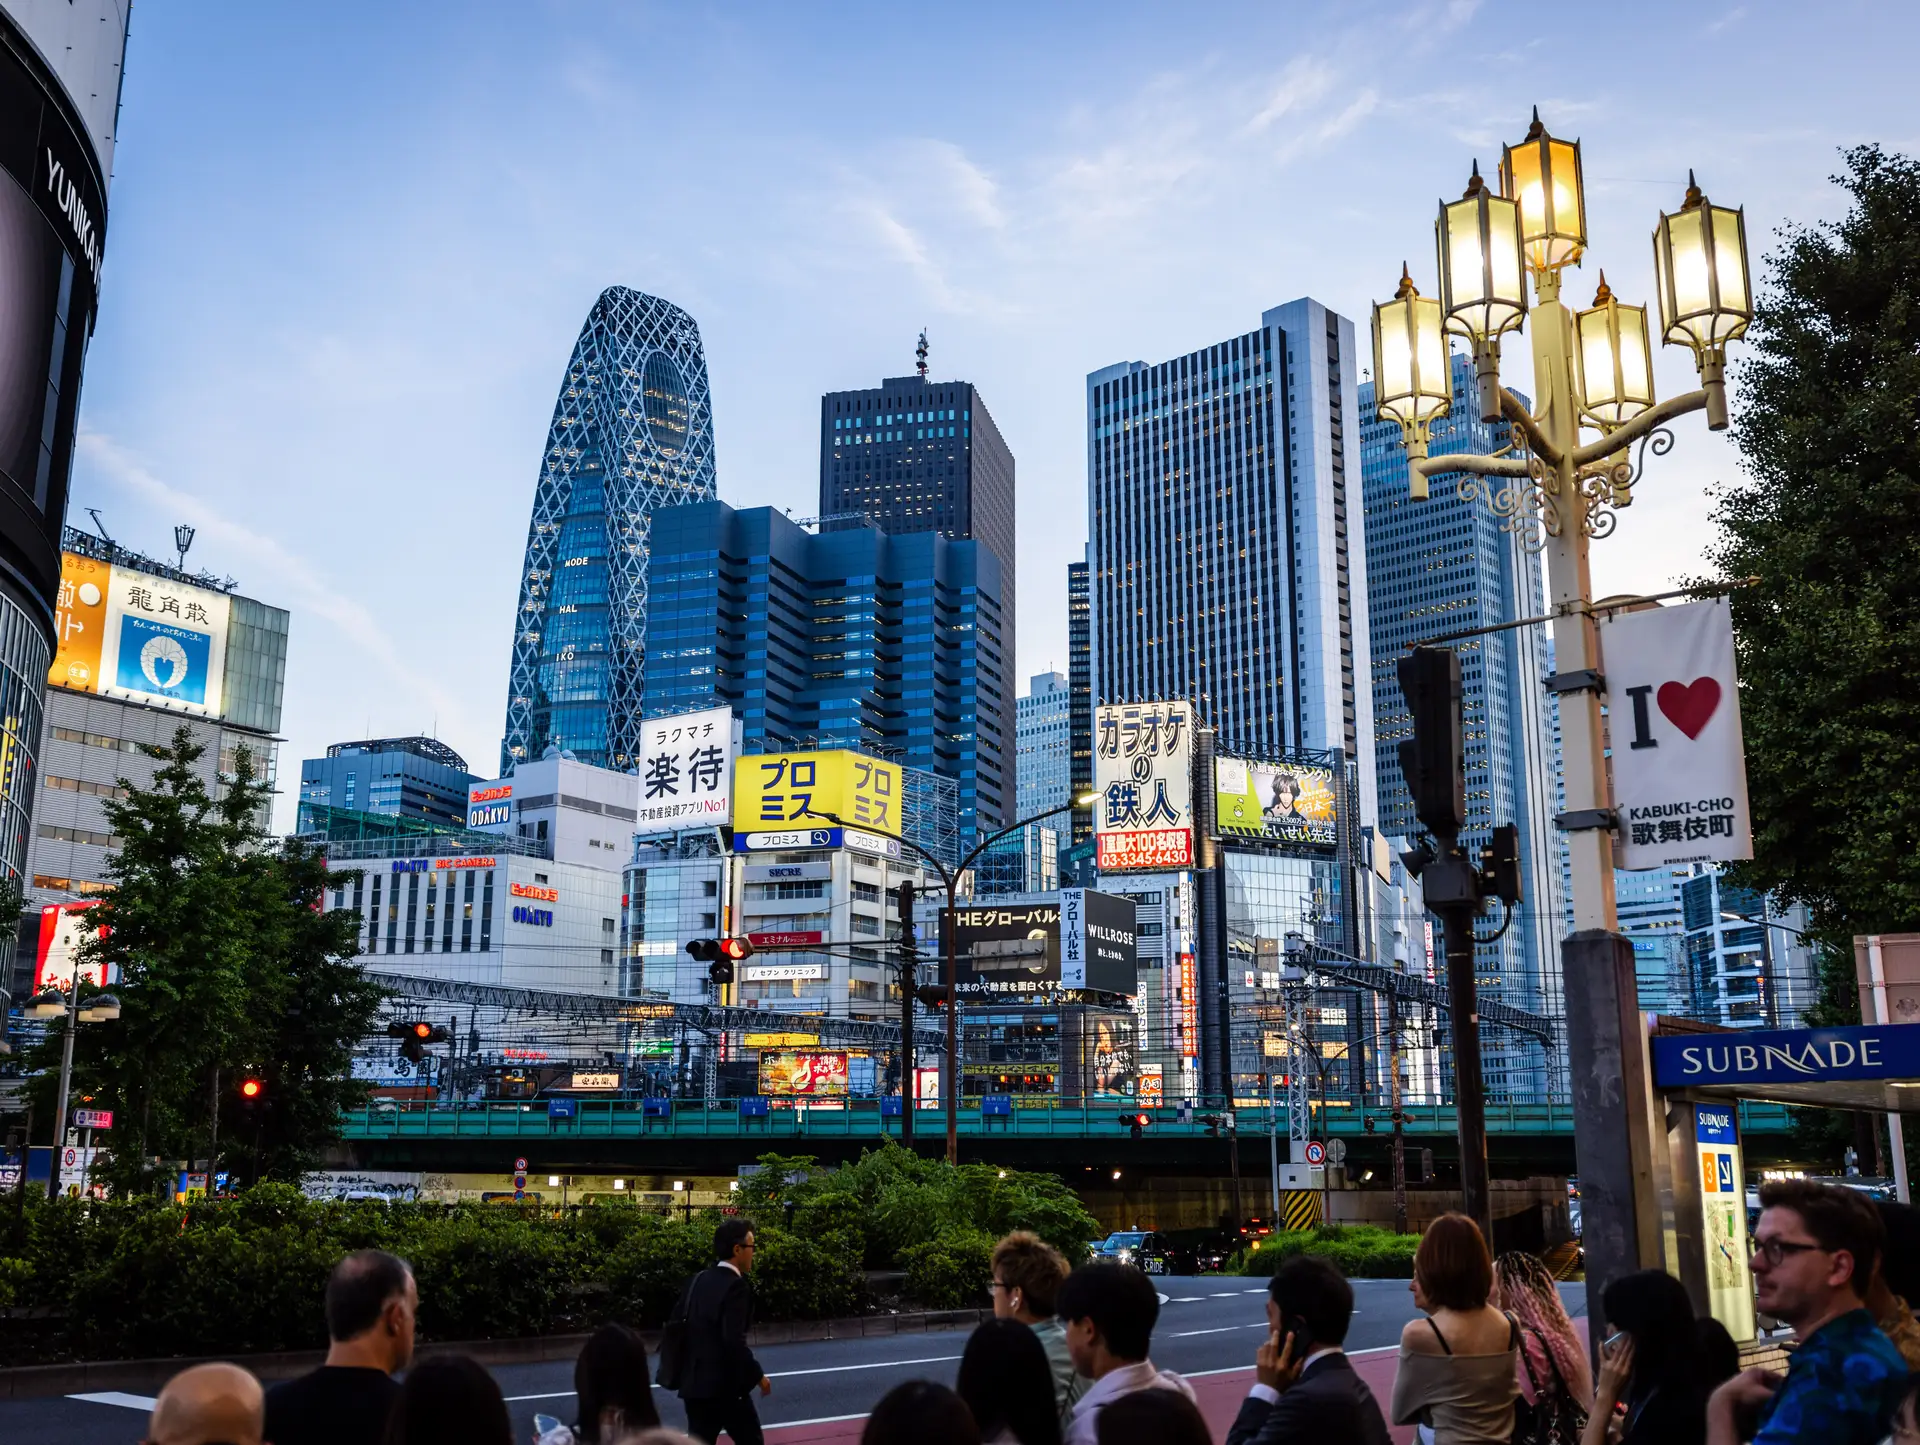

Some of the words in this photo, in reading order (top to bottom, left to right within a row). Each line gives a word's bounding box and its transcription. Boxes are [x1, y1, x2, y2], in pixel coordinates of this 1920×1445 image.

[47, 147, 95, 272] YUNIKA
[565, 557, 588, 567] MODE
[128, 586, 209, 625] 龍角散
[559, 604, 578, 614] HAL
[1625, 684, 1659, 750] I
[656, 722, 715, 746] ラクマチ
[1098, 703, 1186, 759] カラオケ
[644, 744, 724, 800] 楽待
[760, 758, 816, 790] プロ
[854, 761, 891, 797] プロ
[1131, 752, 1152, 785] の
[470, 785, 512, 803] ビックカメラ
[1104, 778, 1181, 828] 鉄人
[471, 805, 510, 828] ODAKYU
[760, 793, 816, 821] ミス
[854, 795, 890, 828] ミス
[1630, 796, 1735, 821] KABUKI-CHO
[762, 834, 800, 846] プロミス
[1260, 823, 1337, 843] たいせい先生
[1631, 813, 1736, 846] 歌舞伎町
[854, 834, 880, 850] プロミス
[1101, 831, 1187, 853] 1室最大100名収容
[392, 859, 428, 873] ODAKYU
[435, 859, 452, 869] BIC
[454, 857, 496, 868] CAMERA
[1101, 850, 1188, 866] 03-3345-6430
[768, 867, 802, 877] SECRE
[510, 882, 559, 903] ビックカメラ
[513, 905, 553, 928] ODAKYU
[1087, 923, 1134, 946] WILLROSE
[784, 968, 816, 976] クリニック
[1682, 1038, 1883, 1074] SUBNADE
[1699, 1112, 1730, 1128] SUBNADE
[1706, 1161, 1713, 1184] 3
